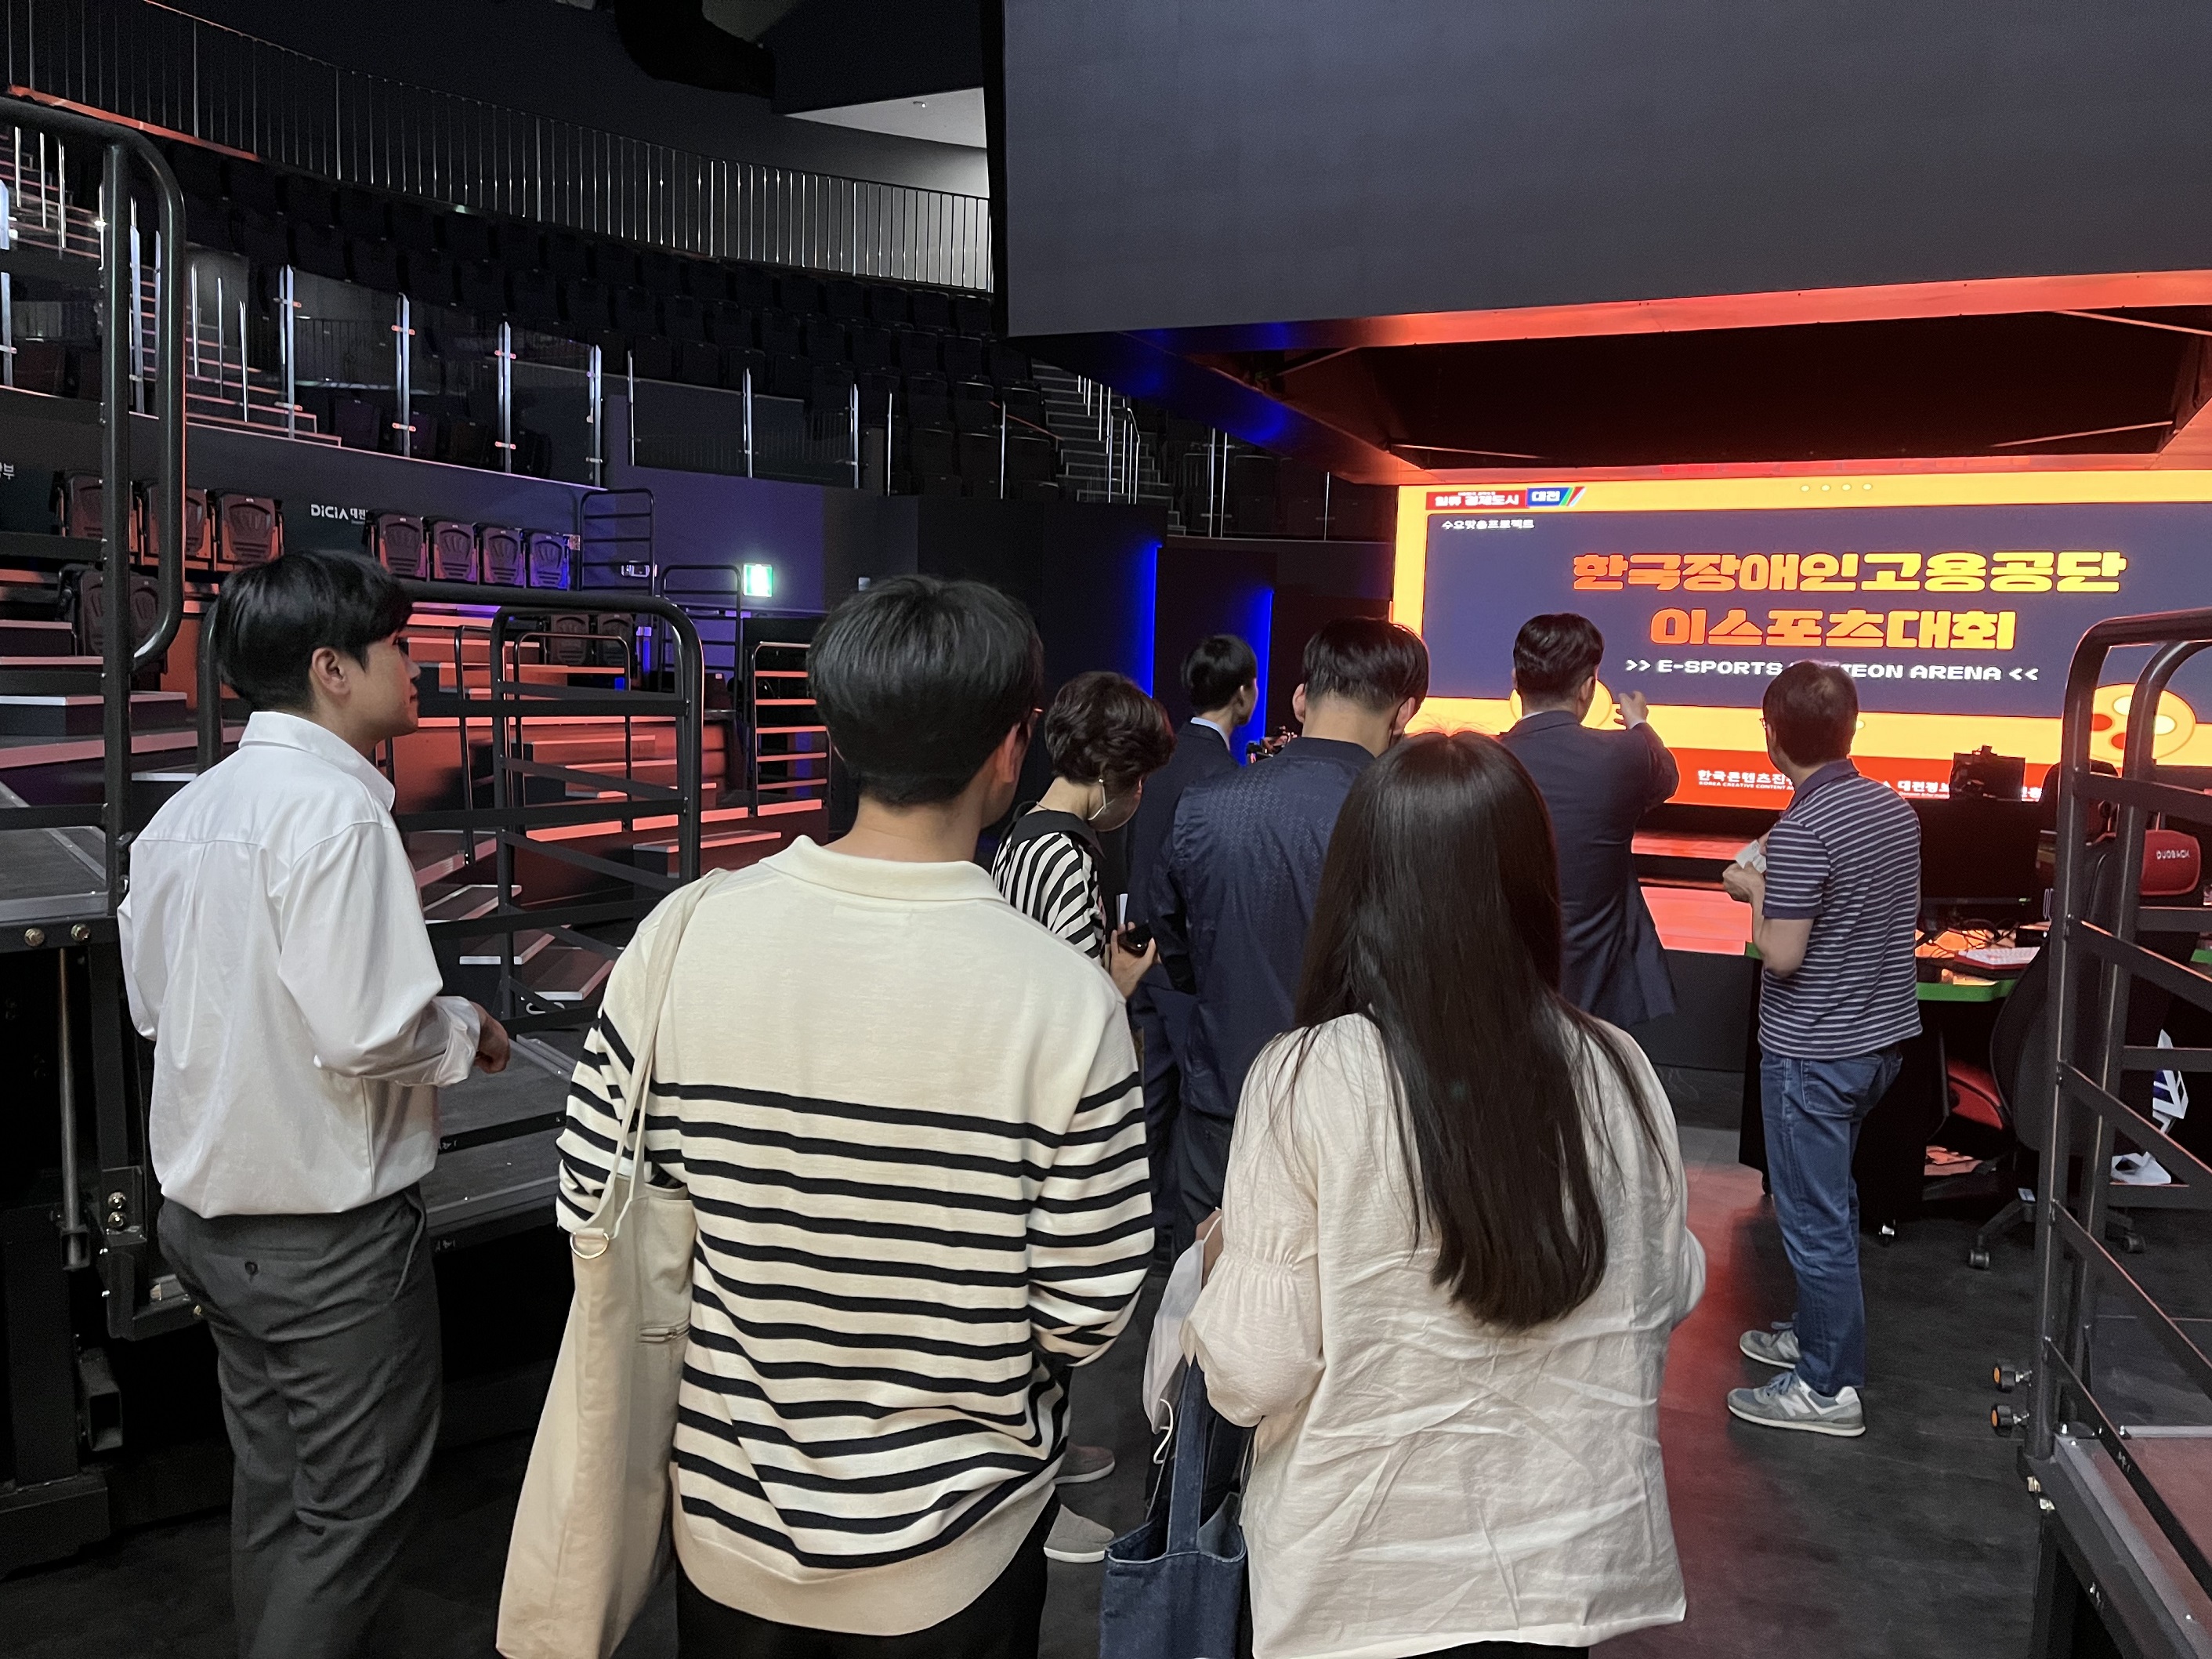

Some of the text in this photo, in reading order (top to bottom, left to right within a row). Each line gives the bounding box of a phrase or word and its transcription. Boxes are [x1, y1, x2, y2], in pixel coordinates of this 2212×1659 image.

[1531, 491, 1560, 502] 대전
[1573, 551, 2128, 593] 한국장애인고용공단
[1650, 607, 2017, 651] 이스포츠대회
[1657, 659, 1783, 677] E-SPORTS
[1910, 665, 2002, 682] ARENA
